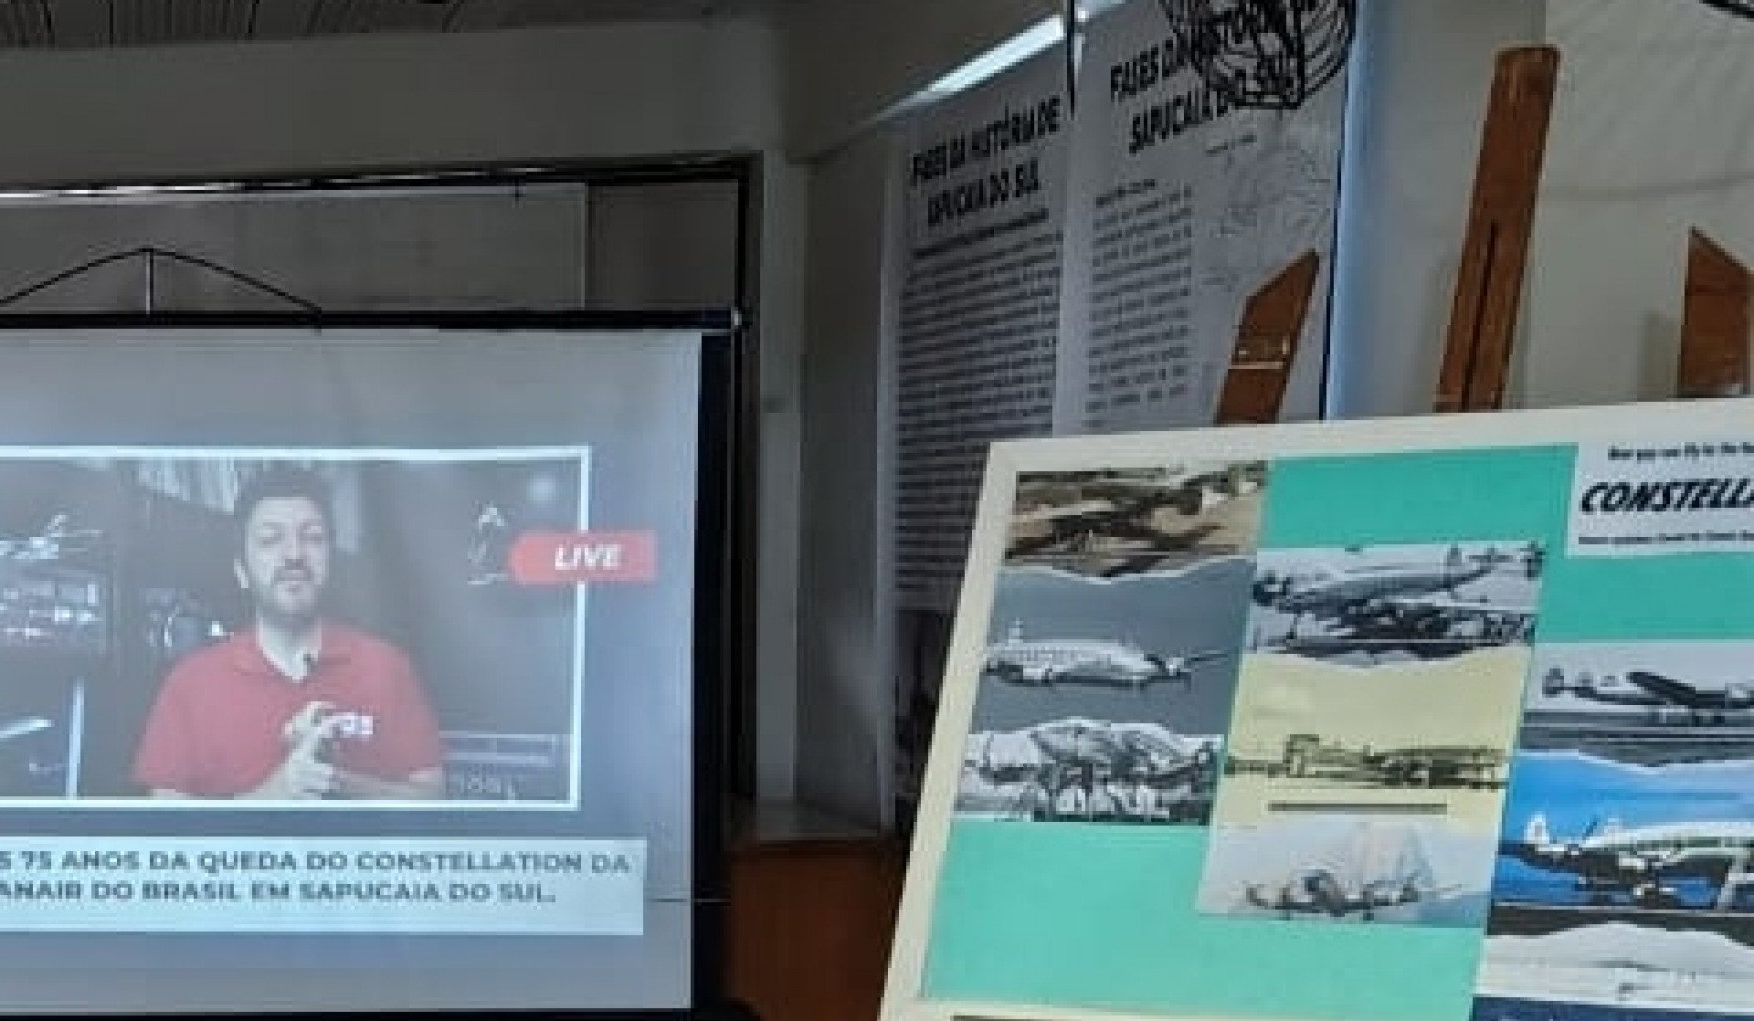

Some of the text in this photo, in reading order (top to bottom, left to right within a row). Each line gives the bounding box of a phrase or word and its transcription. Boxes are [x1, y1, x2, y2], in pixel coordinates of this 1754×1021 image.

[554, 543, 623, 571] LIVE
[20, 850, 52, 871] 75
[61, 850, 141, 871] ANOS
[149, 850, 191, 871] DA
[199, 850, 298, 874] QUEDA
[306, 850, 348, 871] DO
[357, 851, 582, 873] CONSTELLATION
[590, 853, 632, 874] DA
[91, 880, 134, 901] DO
[142, 880, 238, 902] BRASIL
[251, 880, 290, 902] EM
[299, 881, 443, 903] SAPUCAIA
[449, 883, 492, 903] DO
[496, 883, 556, 904] SUL.
